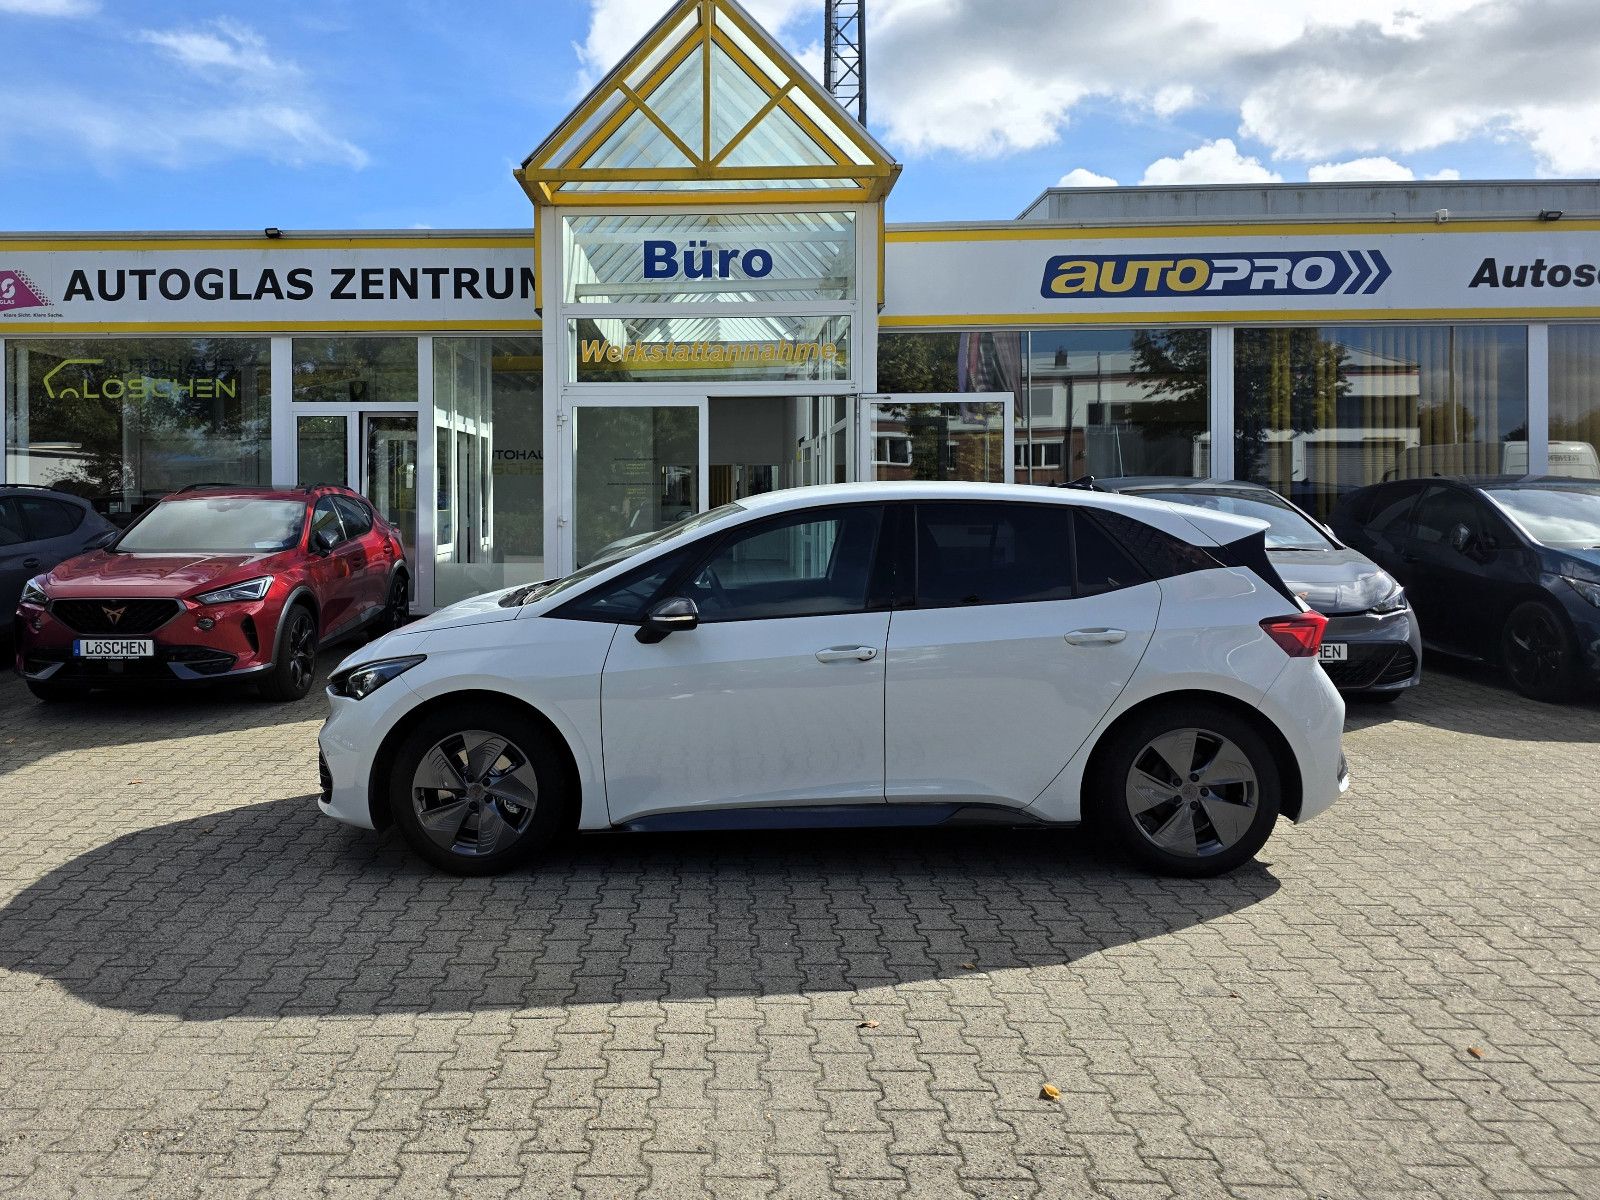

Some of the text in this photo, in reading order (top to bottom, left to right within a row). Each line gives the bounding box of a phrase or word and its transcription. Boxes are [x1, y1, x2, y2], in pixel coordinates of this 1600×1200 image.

[643, 240, 773, 279] Büro
[1468, 257, 1600, 288] Autos
[63, 268, 314, 302] AUTOGLAS
[581, 339, 837, 363] Werkstattannahme
[83, 375, 236, 399] LÖSCHEN
